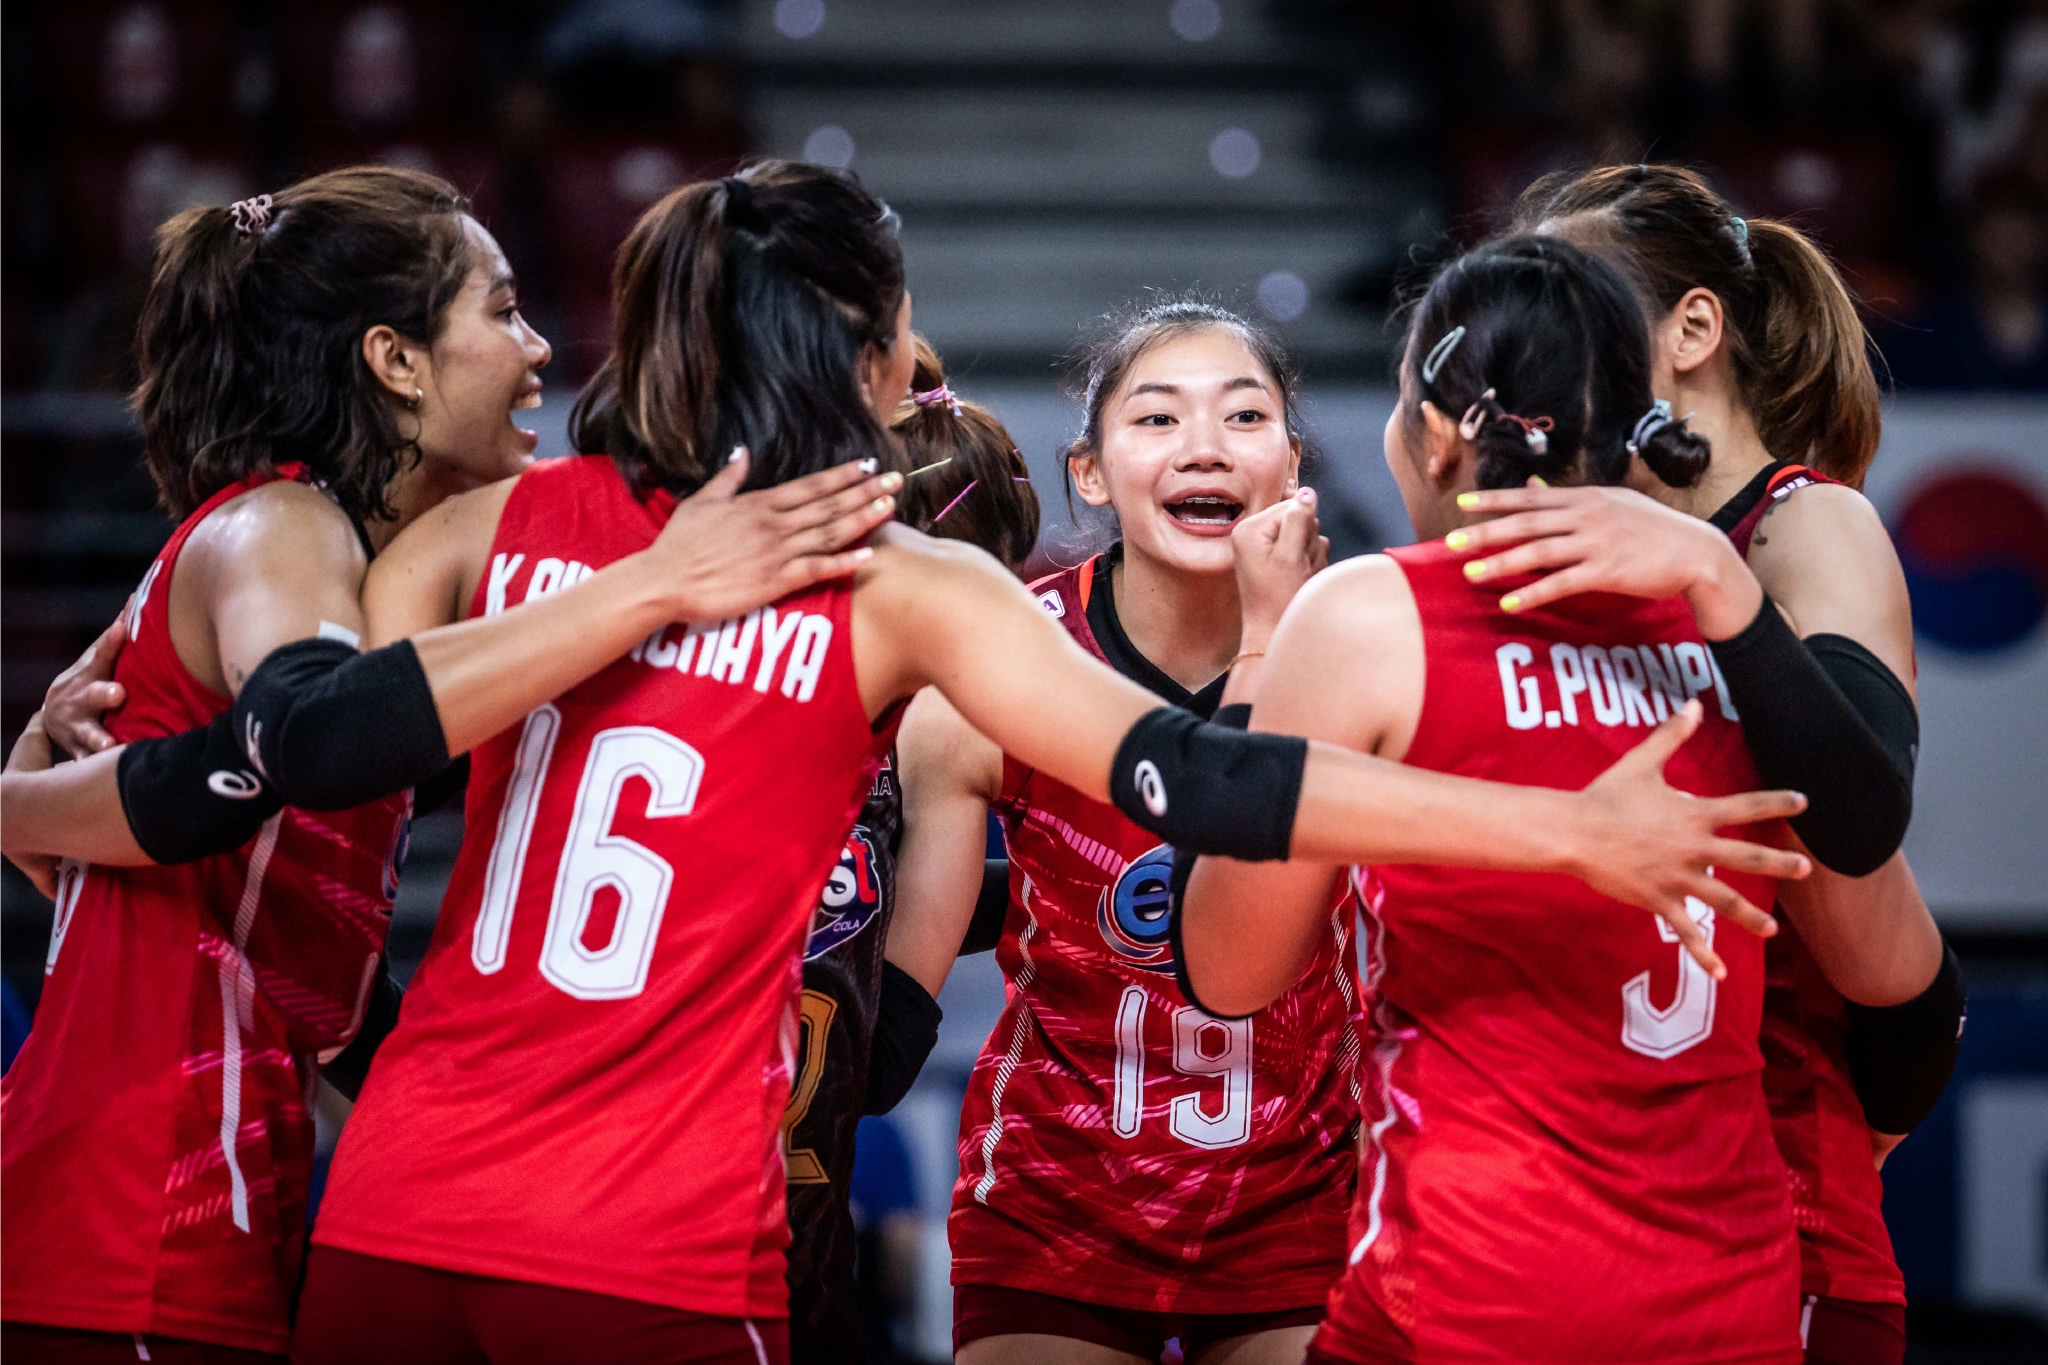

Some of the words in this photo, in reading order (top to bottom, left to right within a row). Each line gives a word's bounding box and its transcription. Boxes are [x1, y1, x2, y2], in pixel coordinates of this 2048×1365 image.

[471, 702, 705, 1001] 16
[832, 918, 861, 932] COLA
[1113, 984, 1254, 1150] 19
